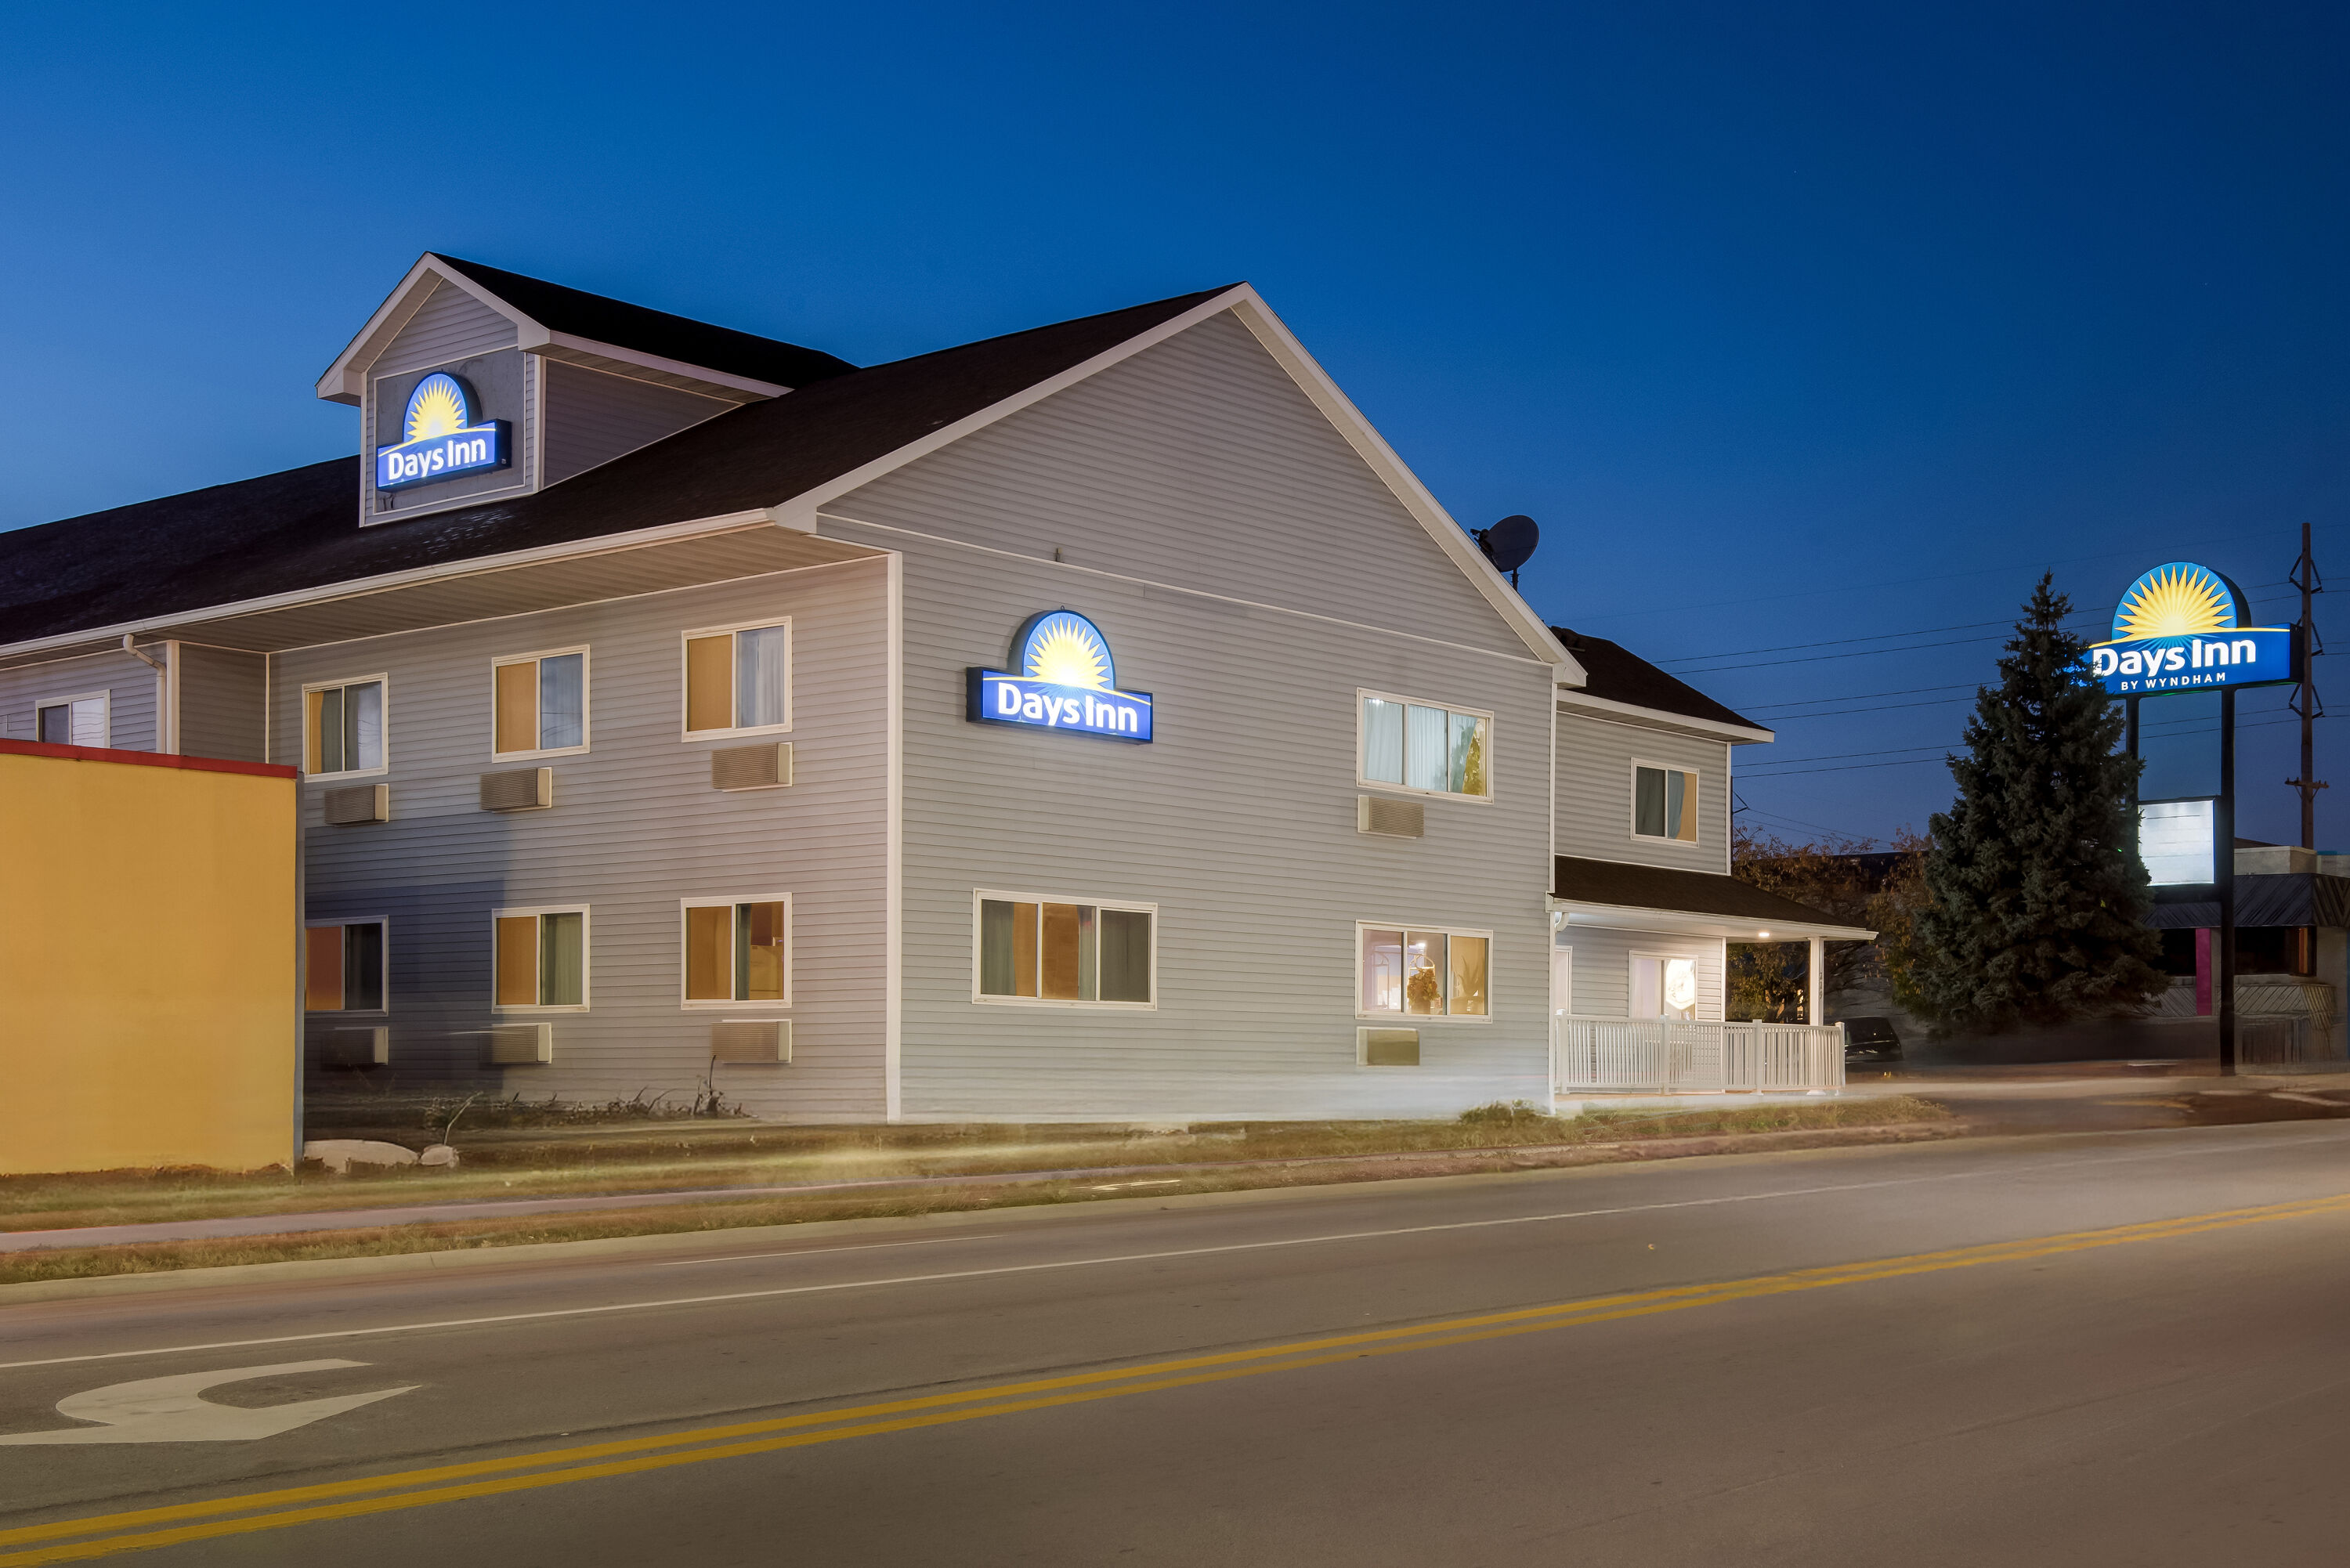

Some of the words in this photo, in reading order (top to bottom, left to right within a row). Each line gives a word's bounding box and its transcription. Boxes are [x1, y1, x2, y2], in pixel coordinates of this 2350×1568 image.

[389, 448, 444, 480] Days
[447, 439, 486, 468] Inn
[2093, 647, 2186, 677] Days
[2192, 639, 2256, 668] Inn
[2121, 680, 2138, 691] BY
[2146, 672, 2225, 688] WYNDHAM
[998, 681, 1079, 726] Days
[1086, 695, 1137, 732] Inn
